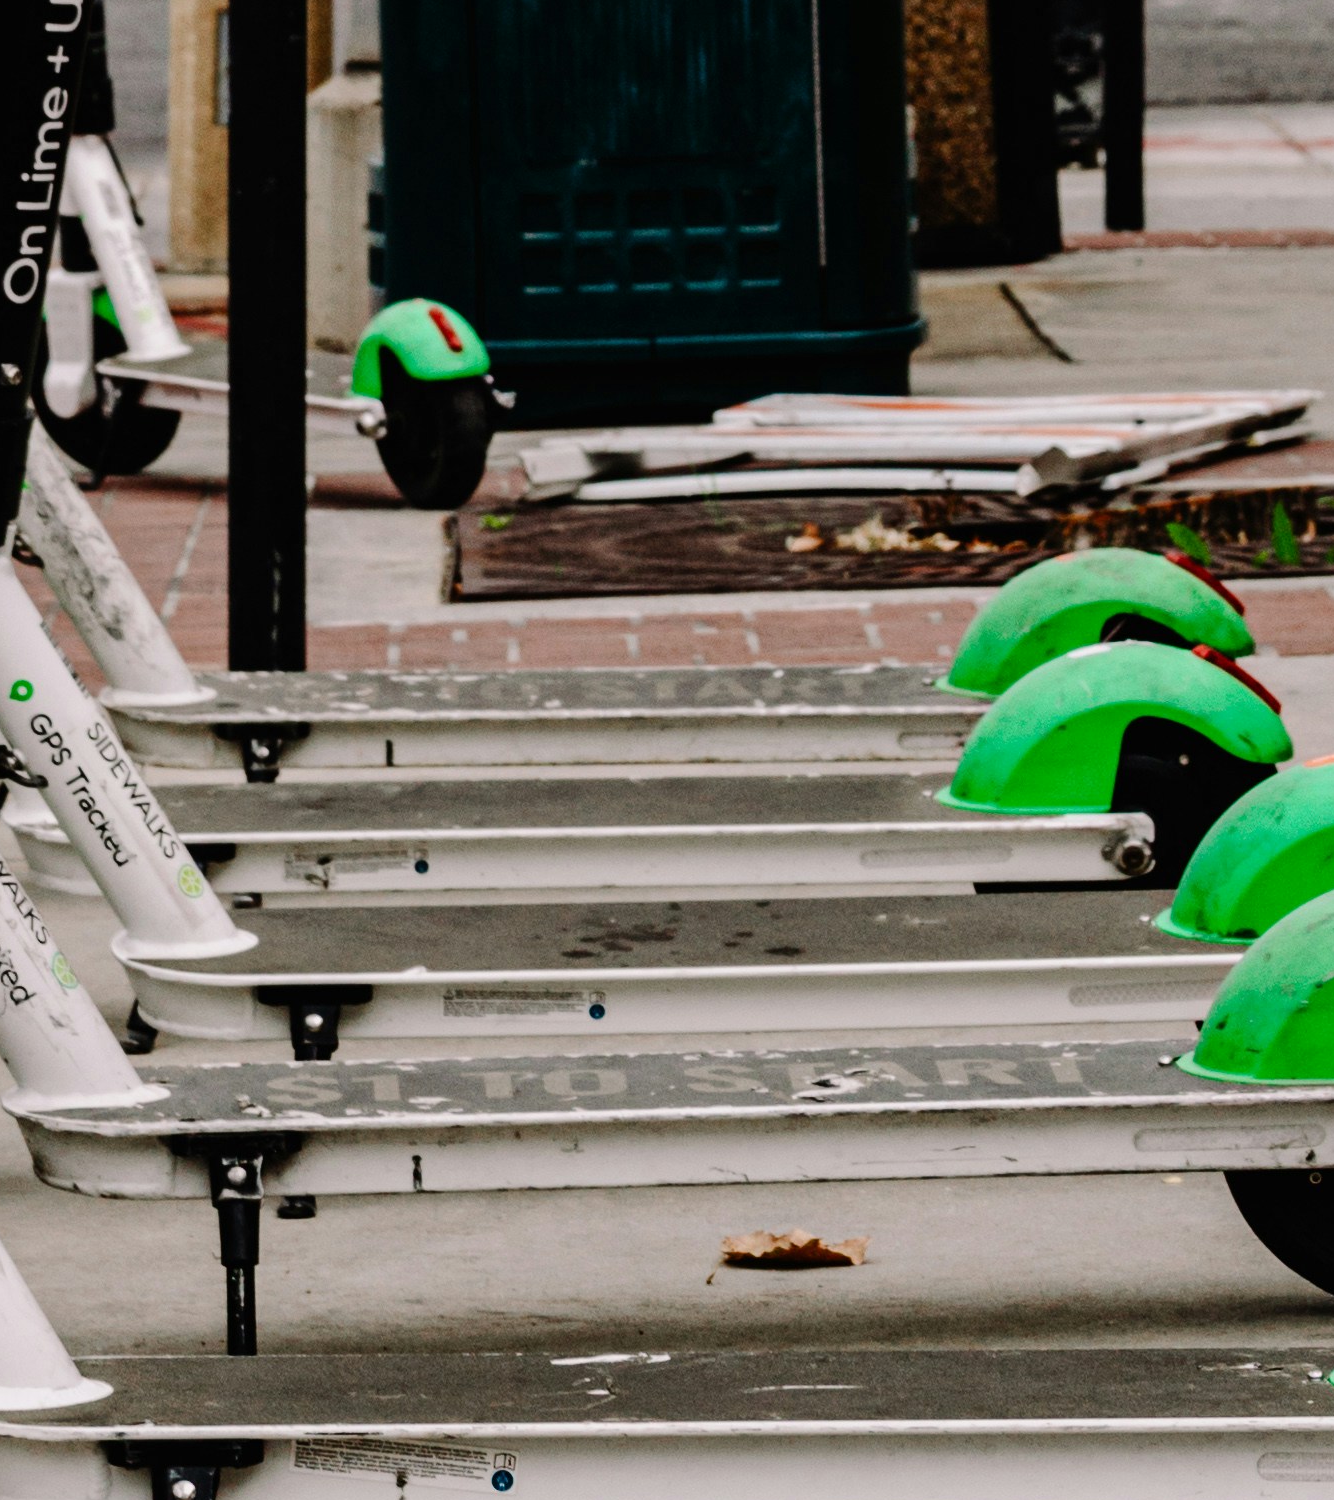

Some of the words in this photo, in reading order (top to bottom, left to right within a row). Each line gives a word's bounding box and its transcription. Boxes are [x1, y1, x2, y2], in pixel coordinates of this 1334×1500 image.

[15, 85, 69, 211] Lime
[3, 224, 48, 305] On
[29, 712, 73, 767] GPS
[86, 721, 181, 860] SIDEWALKS
[265, 1071, 404, 1109] $1
[460, 1067, 629, 1100] TO
[682, 1055, 1096, 1097] START
